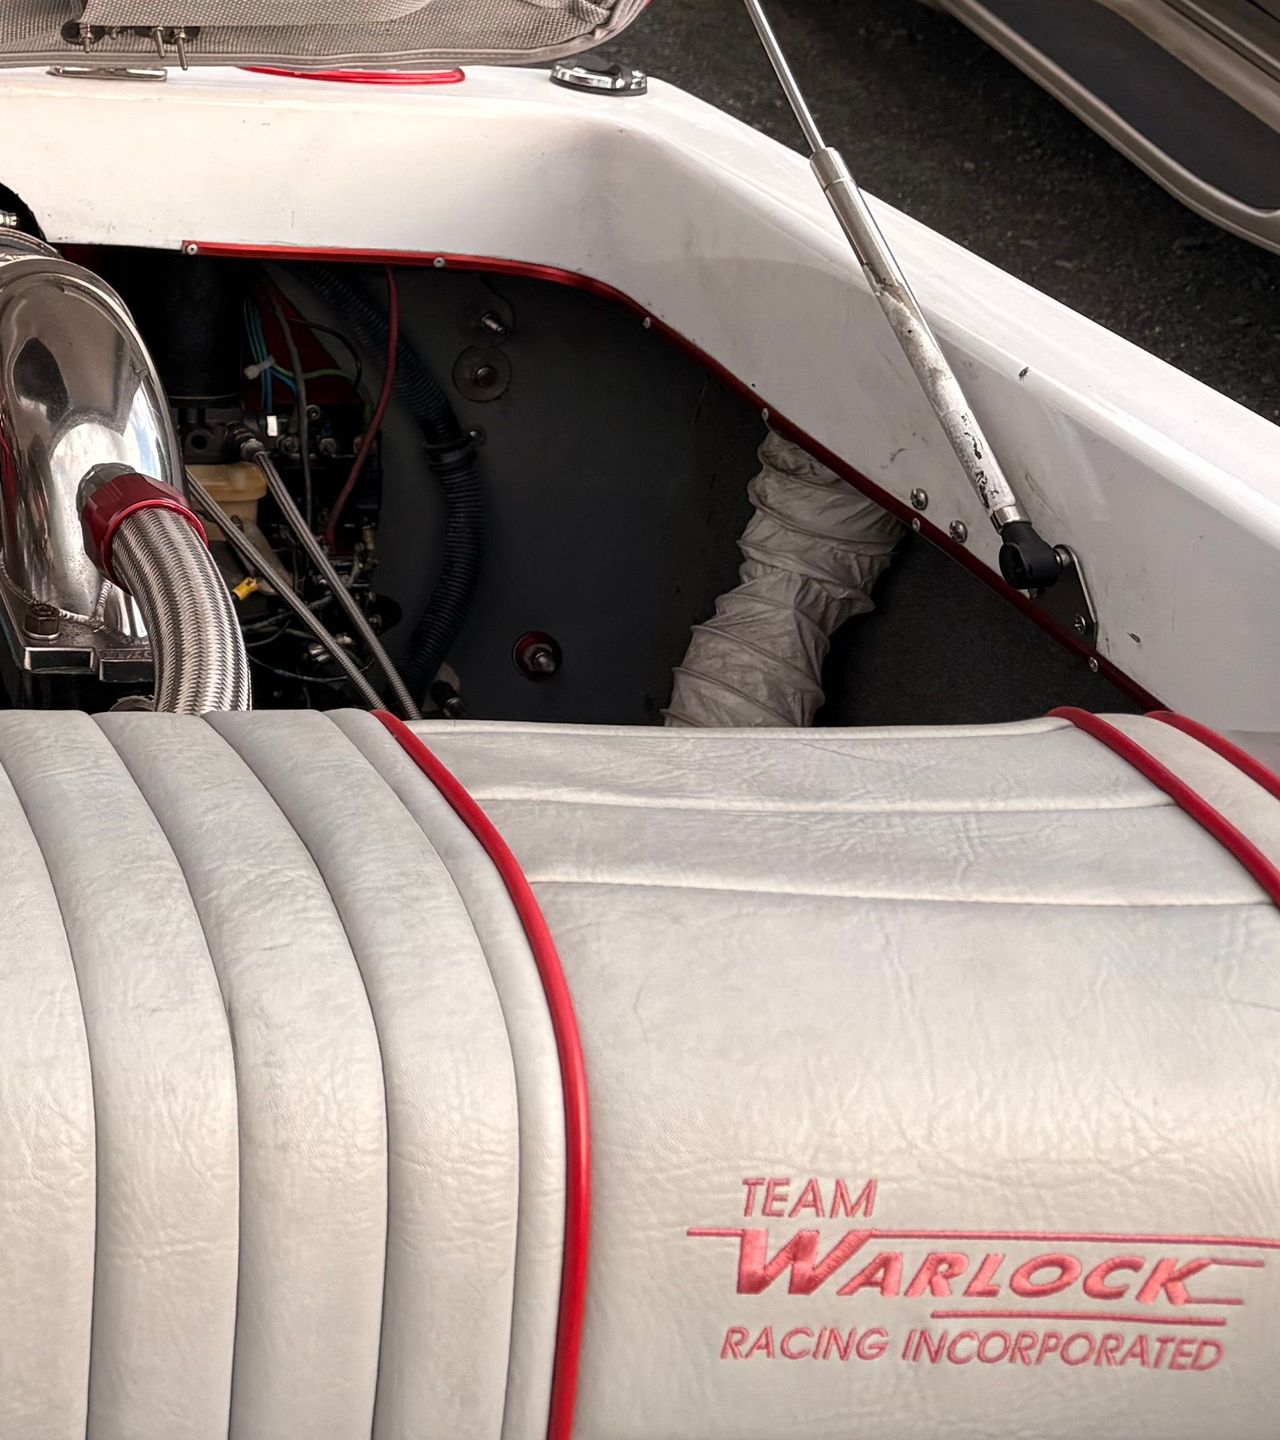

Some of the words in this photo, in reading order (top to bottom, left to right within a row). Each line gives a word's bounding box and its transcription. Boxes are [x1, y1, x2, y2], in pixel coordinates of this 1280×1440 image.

[742, 1176, 878, 1219] TEAM
[736, 1228, 1212, 1306] WARLOCK
[720, 1325, 890, 1362] RACING
[902, 1328, 1226, 1372] INCORPORATED
